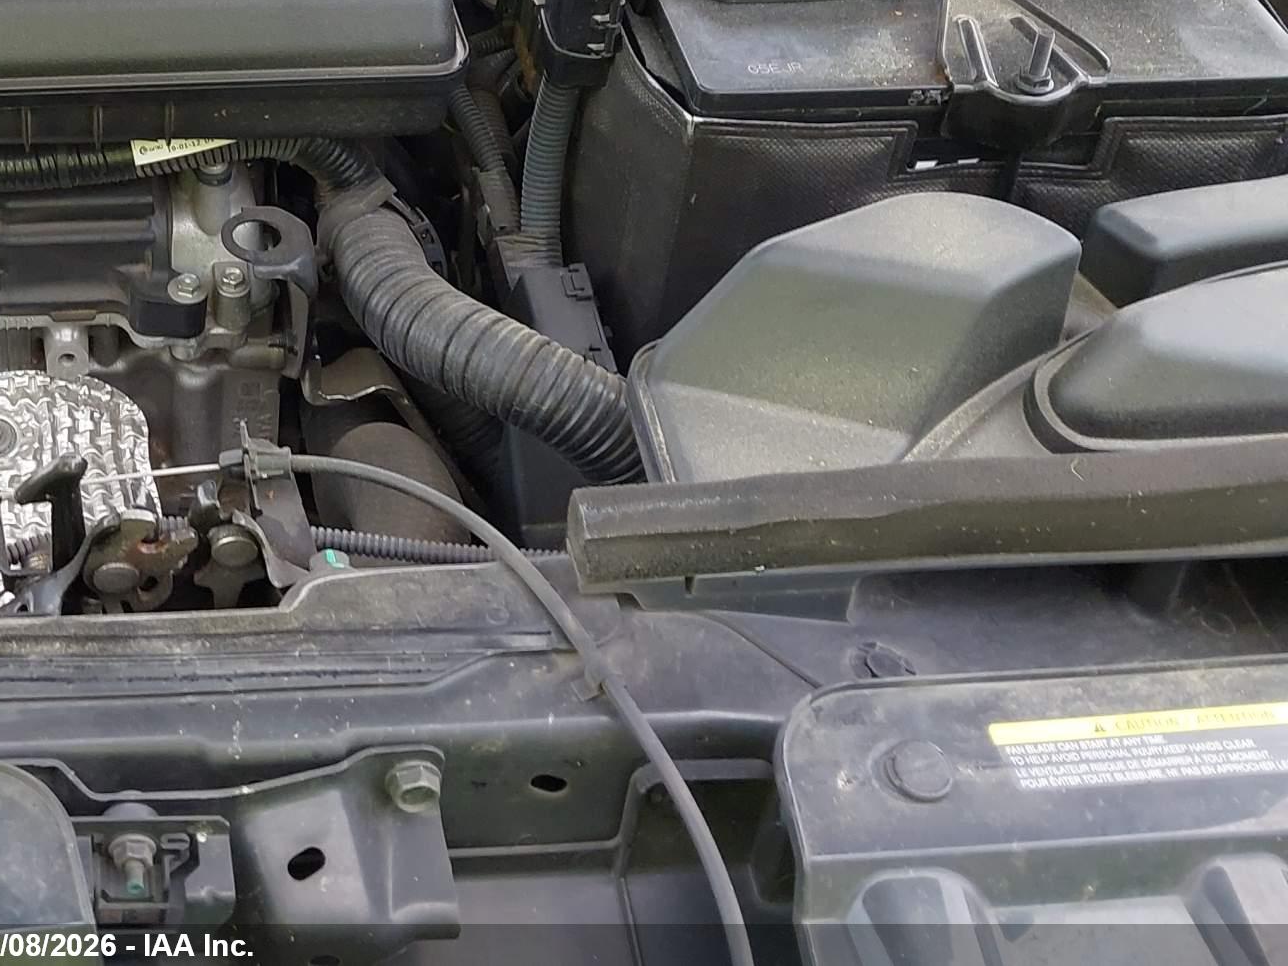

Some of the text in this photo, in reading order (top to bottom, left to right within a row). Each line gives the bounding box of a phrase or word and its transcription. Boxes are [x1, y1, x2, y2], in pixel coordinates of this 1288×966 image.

[1115, 715, 1180, 732] CAUTION
[1004, 745, 1025, 754] FAN
[1024, 743, 1057, 753] BLADE
[1056, 741, 1079, 751] CAN
[1077, 739, 1108, 749] START
[1108, 738, 1122, 747] AT
[1120, 737, 1142, 746] ANY
[1009, 755, 1025, 765] TO
[1023, 754, 1051, 763] HELP
[1049, 751, 1081, 762] AVOID
[1079, 748, 1132, 759] PERSONAL
[1186, 741, 1223, 751] HANDS
[1019, 777, 1050, 787] POUR
[1081, 773, 1114, 783] TOUTE
[1179, 766, 1202, 776] PAS
[1215, 761, 1277, 773] APPROCHER
[1027, 763, 1090, 776] VENTILATEUR
[1088, 760, 1127, 771] RISQUE
[1200, 753, 1228, 763] TOUT
